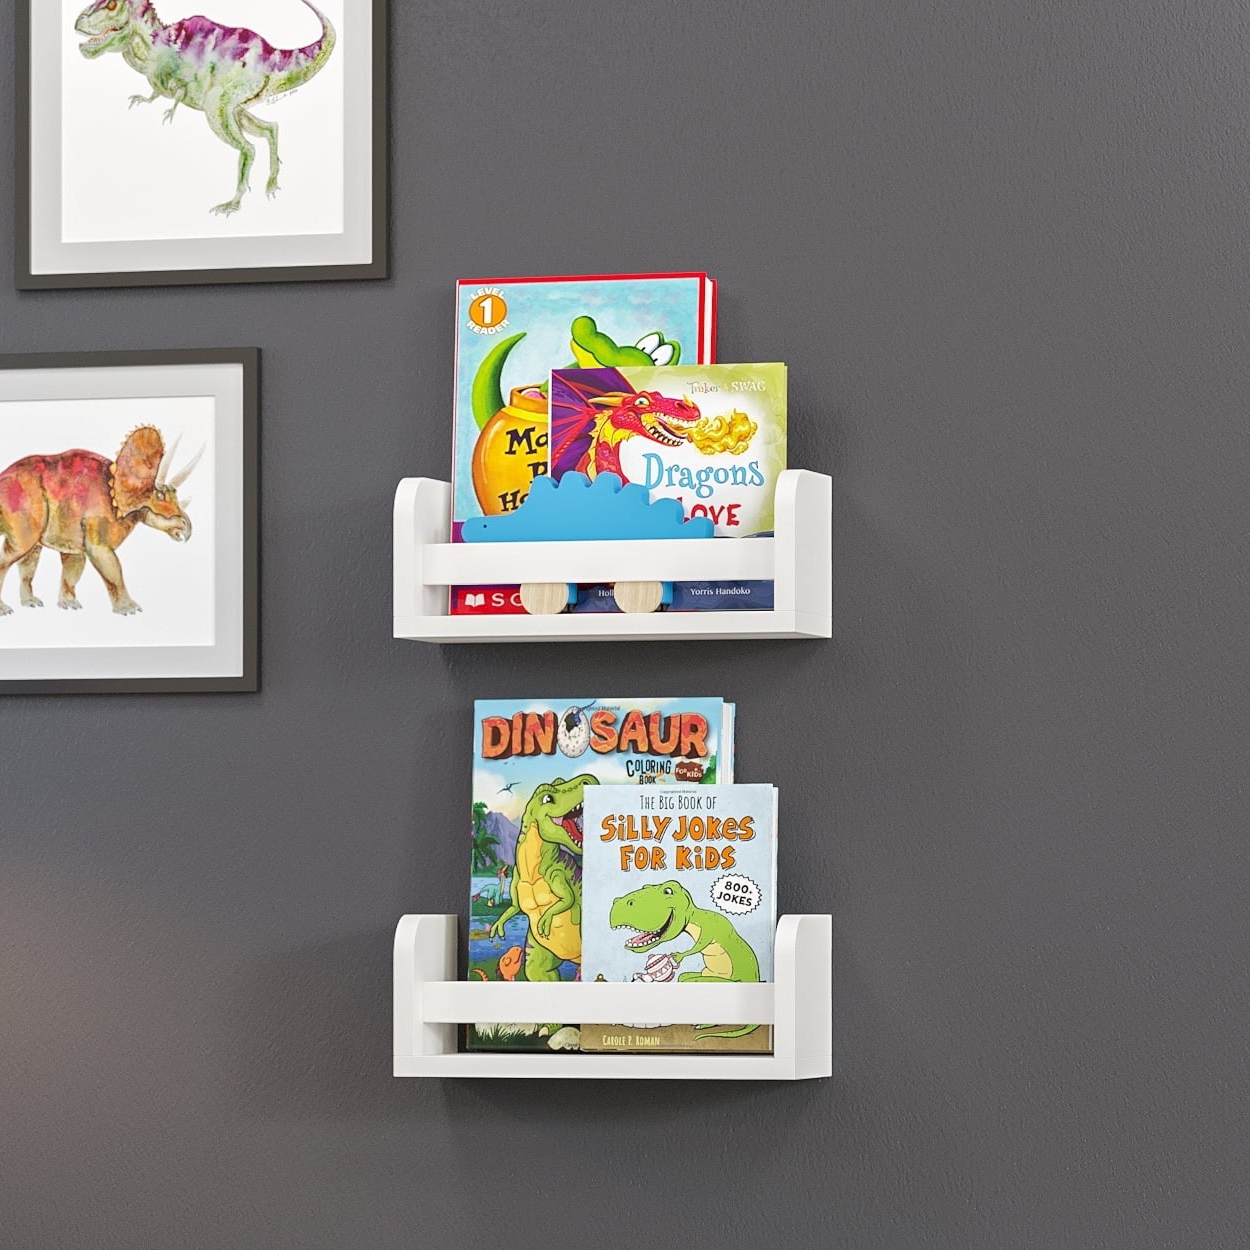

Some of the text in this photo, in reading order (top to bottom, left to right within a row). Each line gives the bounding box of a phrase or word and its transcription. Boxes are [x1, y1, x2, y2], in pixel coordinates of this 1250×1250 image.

[470, 287, 505, 300] LEVEL
[479, 297, 492, 325] 1
[466, 320, 510, 335] READER
[641, 452, 765, 499] Dragons
[690, 586, 751, 596] Yorris Handoko
[481, 705, 708, 760] DINOSAUR
[639, 775, 656, 785] BOOK
[640, 794, 717, 810] THE BIG BOOK OF
[619, 844, 667, 872] FOR
[716, 891, 752, 907] JOKES
[602, 1034, 626, 1046] CAROLE
[635, 1035, 660, 1046] ROMAN
